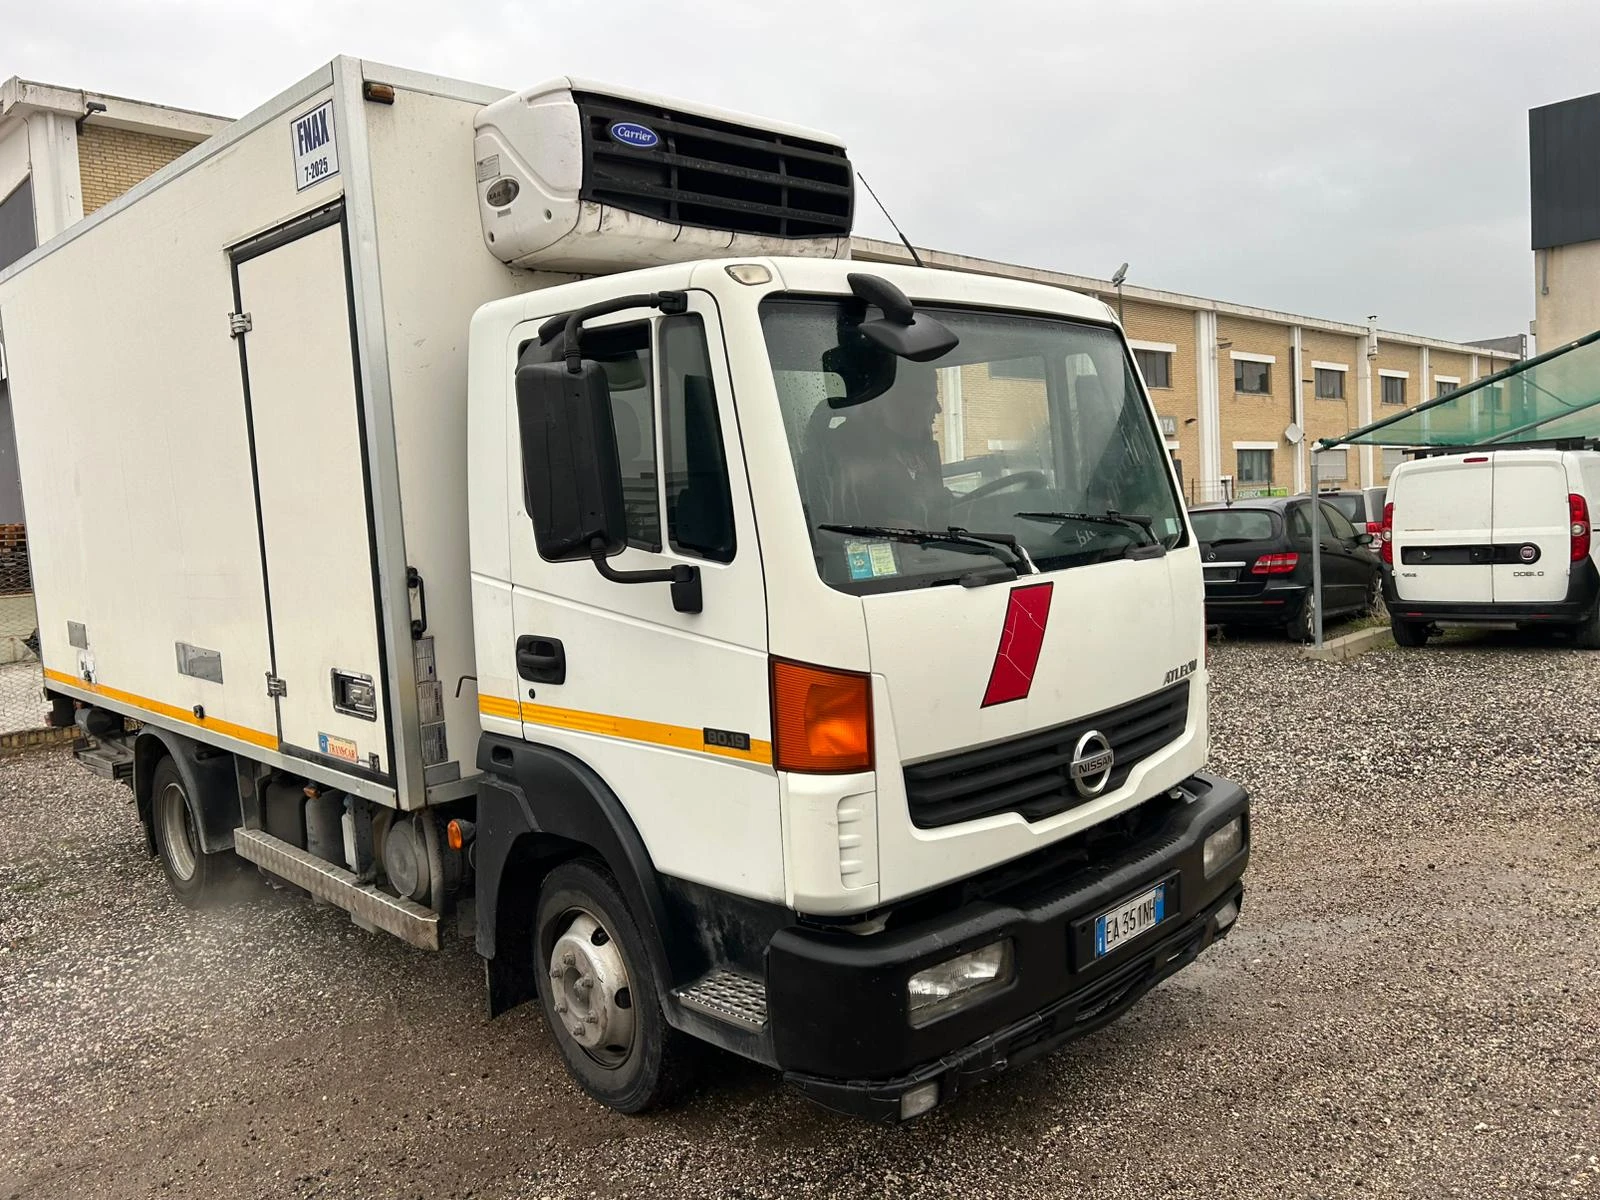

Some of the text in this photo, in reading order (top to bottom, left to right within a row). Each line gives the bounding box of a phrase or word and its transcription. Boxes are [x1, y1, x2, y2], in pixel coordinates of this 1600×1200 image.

[296, 107, 330, 157] FNAX
[617, 126, 653, 142] Carrier
[304, 156, 329, 182] 7-2025
[1078, 754, 1112, 774] NISSAN
[1106, 916, 1120, 945] EA
[1122, 896, 1157, 935] 351NH
